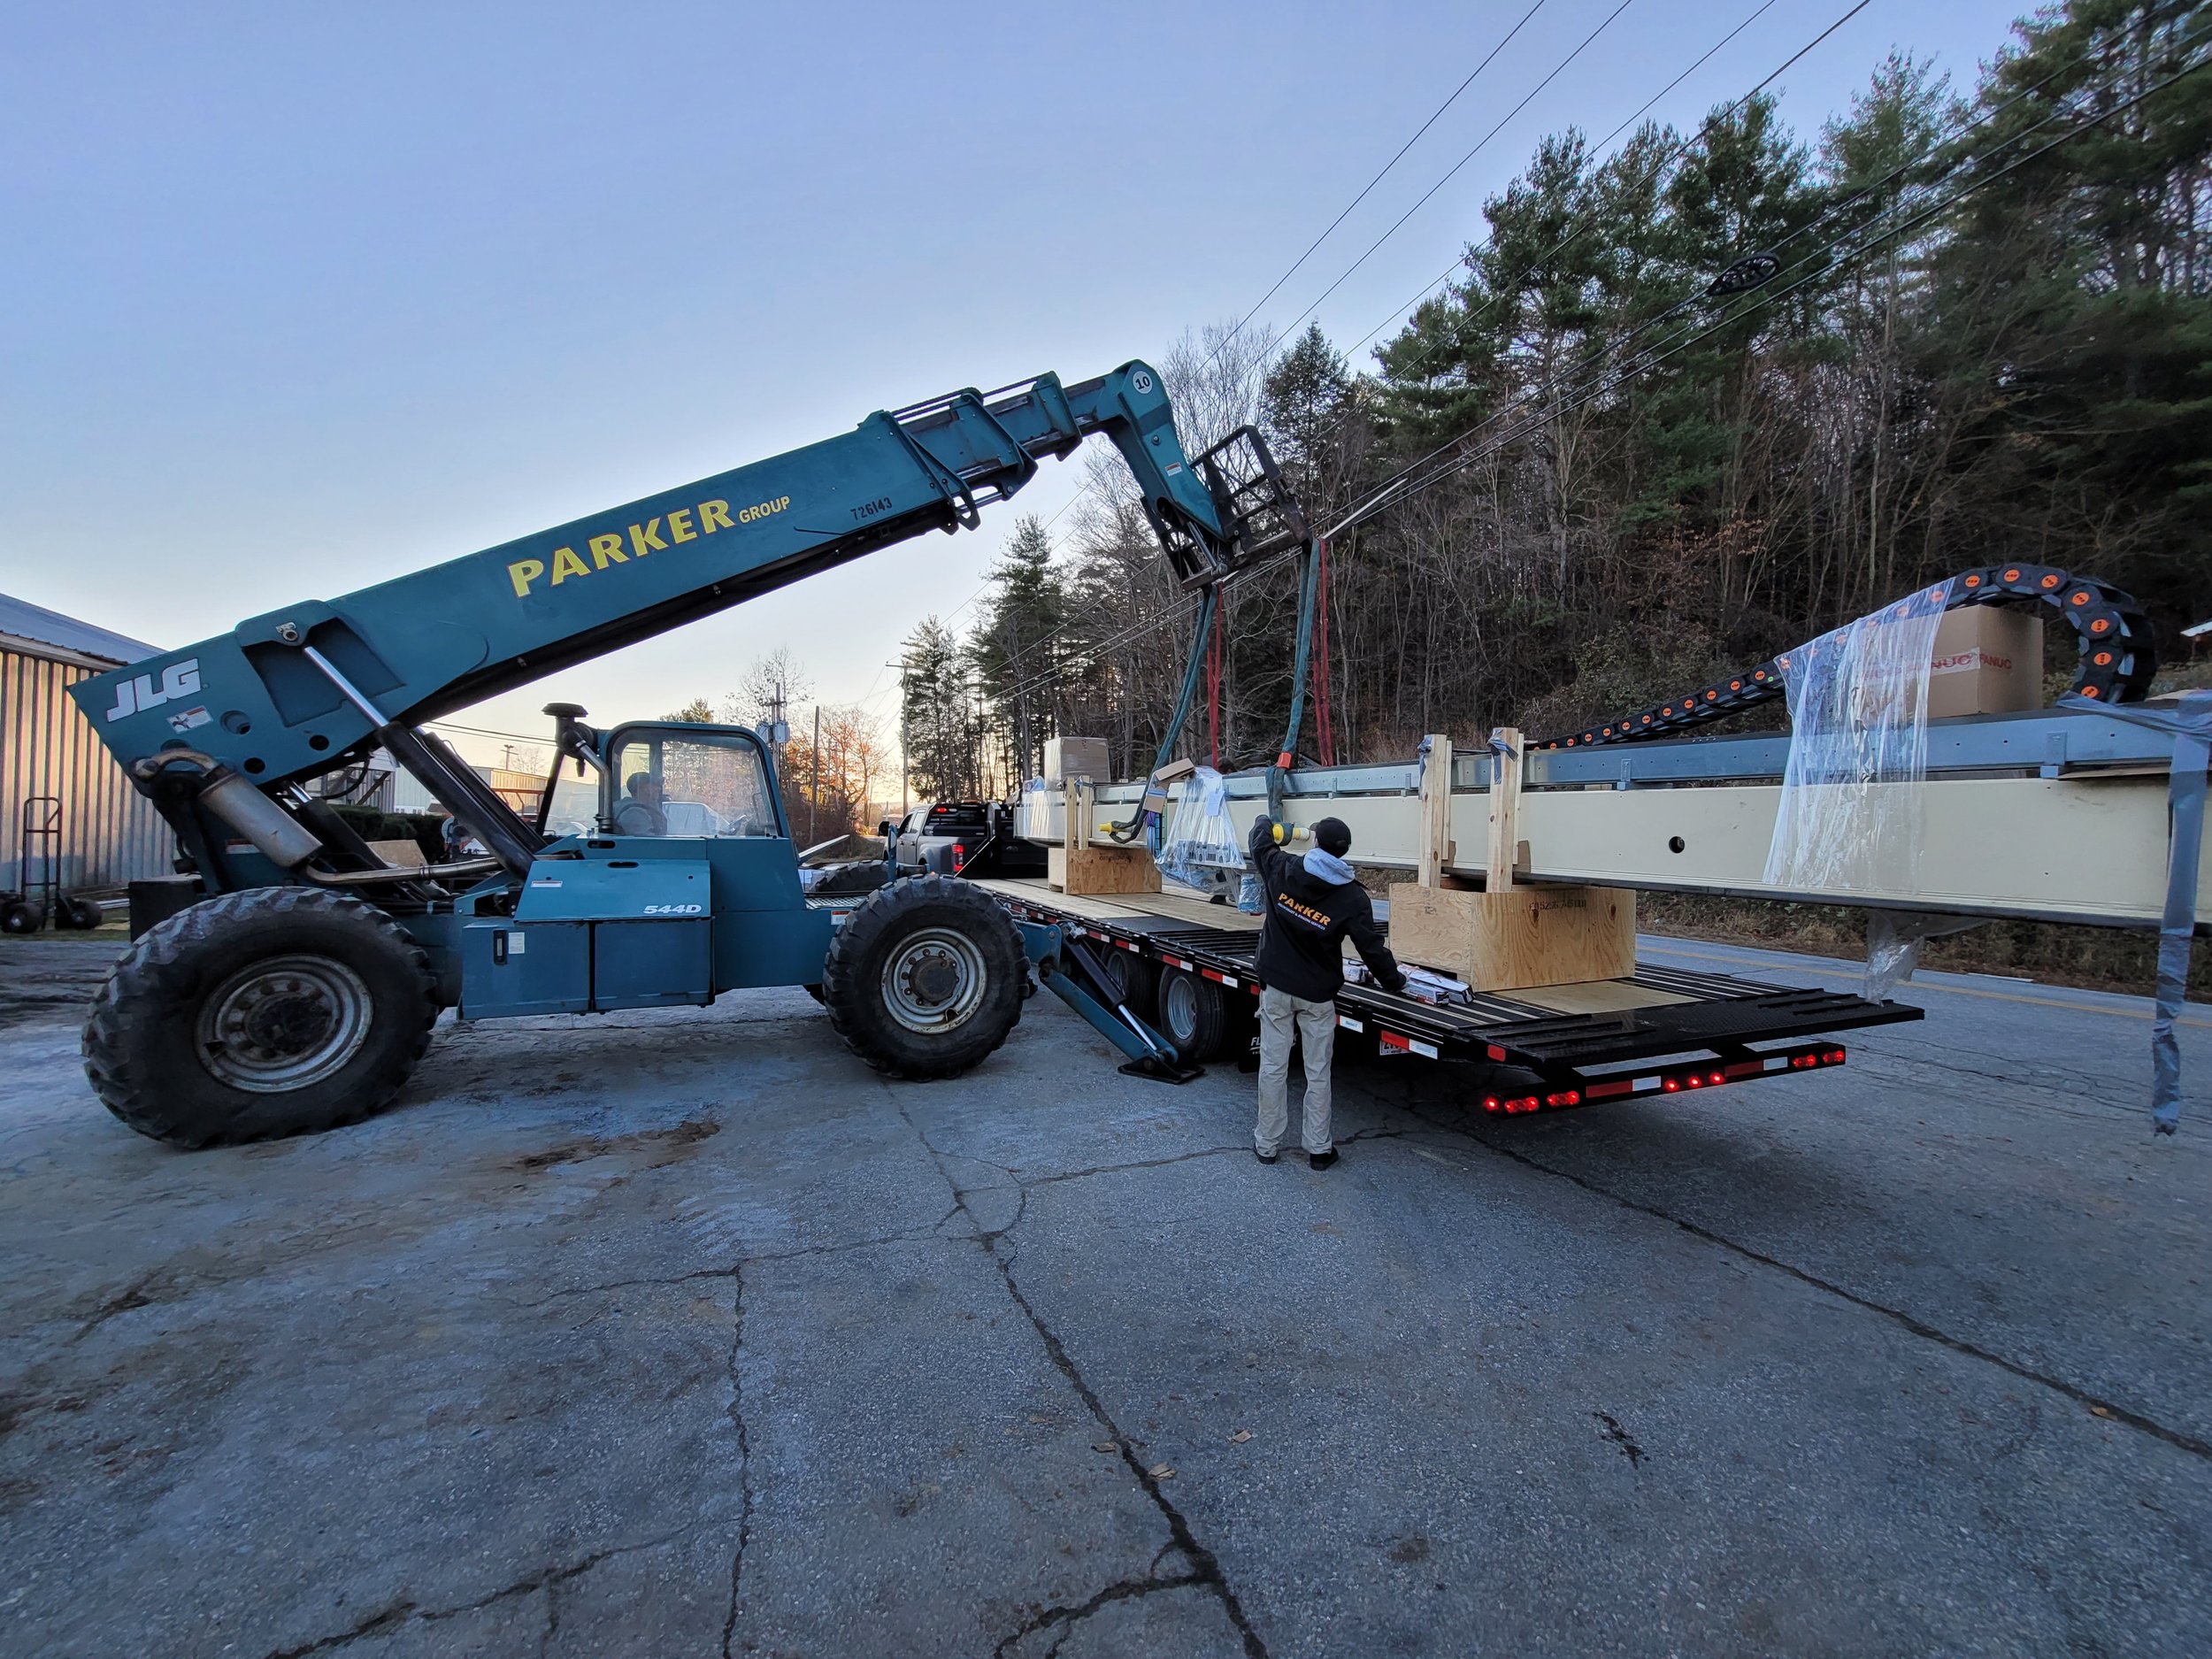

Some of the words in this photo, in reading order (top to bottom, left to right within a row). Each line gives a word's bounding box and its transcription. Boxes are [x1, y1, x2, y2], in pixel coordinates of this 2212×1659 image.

[1135, 376, 1150, 390] 10
[850, 496, 893, 521] 726143
[507, 499, 736, 599] PARKER
[739, 495, 790, 524] GROUP
[1979, 654, 2013, 670] FANUC
[106, 657, 202, 723] JLG
[643, 904, 702, 914] 544D
[1279, 893, 1331, 926] PARKER
